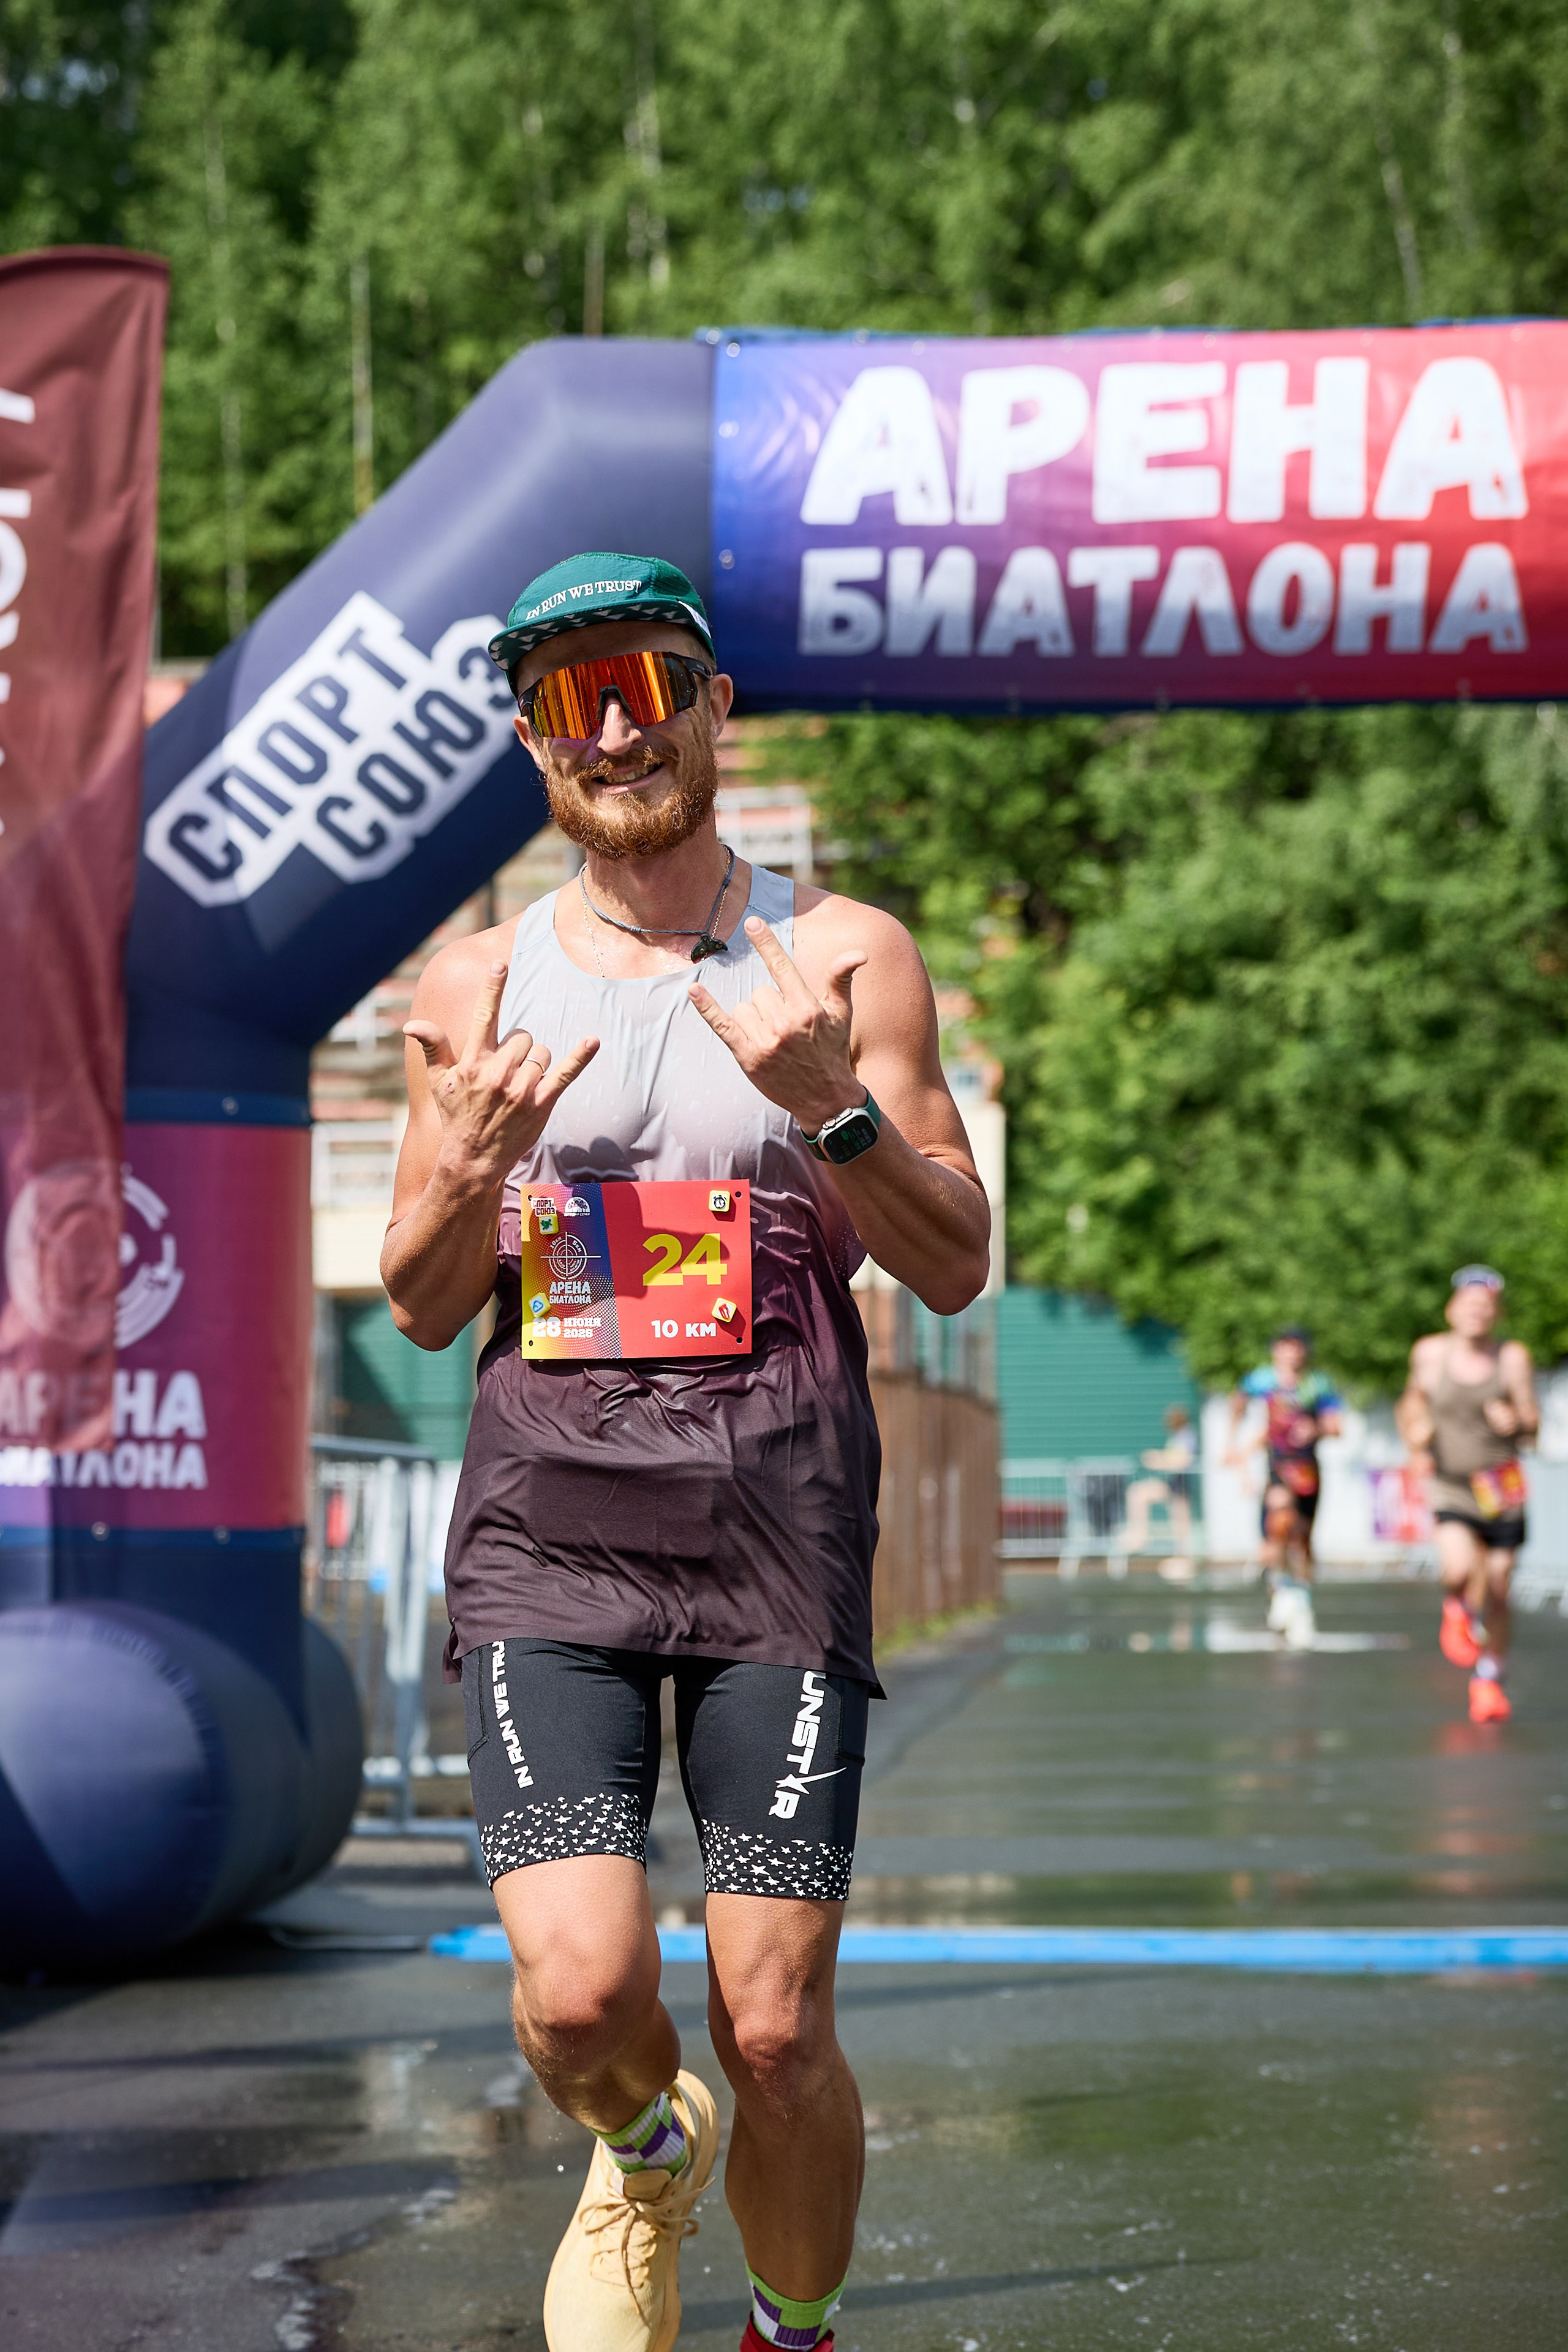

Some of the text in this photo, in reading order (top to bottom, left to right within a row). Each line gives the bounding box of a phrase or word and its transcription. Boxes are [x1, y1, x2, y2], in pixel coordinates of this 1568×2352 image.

[800, 356, 1529, 526] АРЕНА
[525, 579, 642, 620] IN RUN WE TRUST
[797, 541, 1528, 657] БИАТЛОНА
[168, 627, 407, 882] СПОРТ
[316, 646, 516, 858] СОЮЗ
[643, 1233, 728, 1286] 24
[549, 1281, 591, 1294] АРЕНА
[549, 1295, 592, 1304] БИАТЛОНА
[532, 1316, 602, 1338] 28 ИЮНЯ
[564, 1329, 594, 1338] 2026
[651, 1319, 679, 1338] 10
[493, 1681, 510, 1719] WE
[499, 1719, 526, 1765] RUN
[513, 1765, 534, 1789] IN
